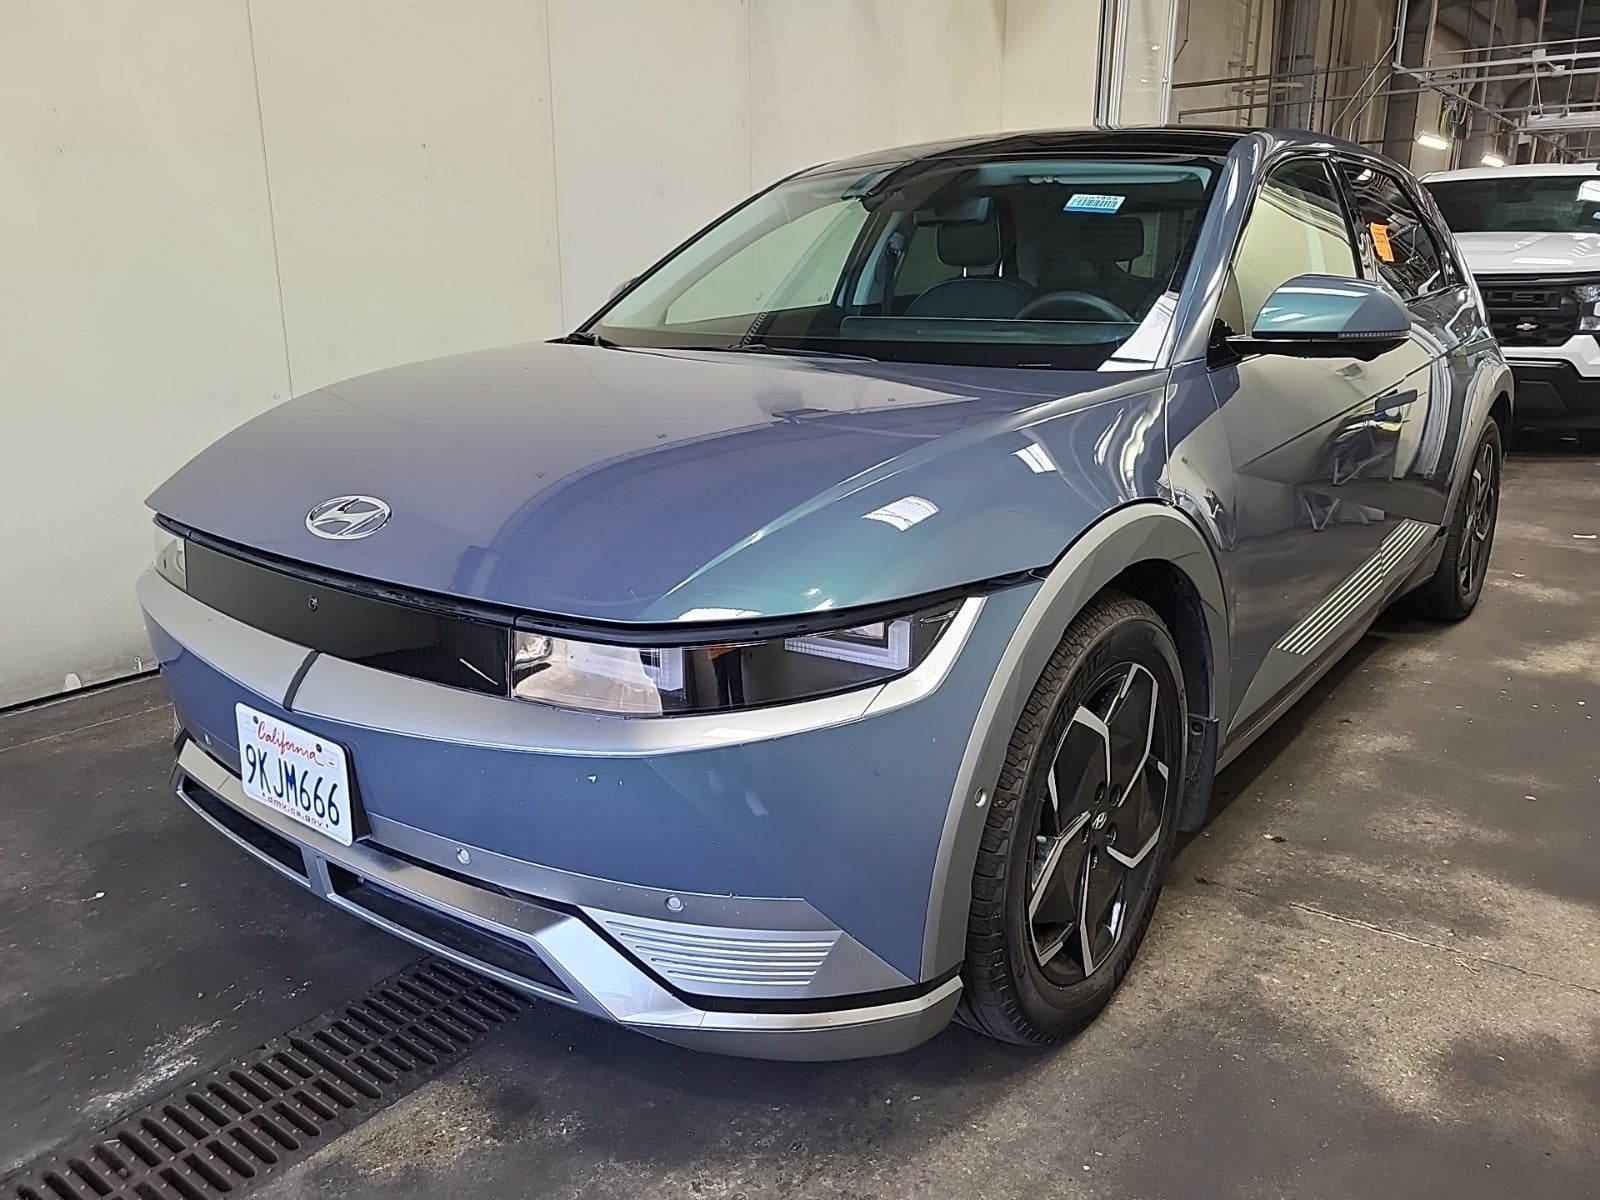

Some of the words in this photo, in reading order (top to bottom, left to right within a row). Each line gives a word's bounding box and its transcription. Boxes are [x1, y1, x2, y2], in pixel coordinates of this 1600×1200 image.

[257, 721, 324, 766] California
[245, 743, 340, 826] 9KJM666
[267, 796, 323, 827] dmv.ca.gov
